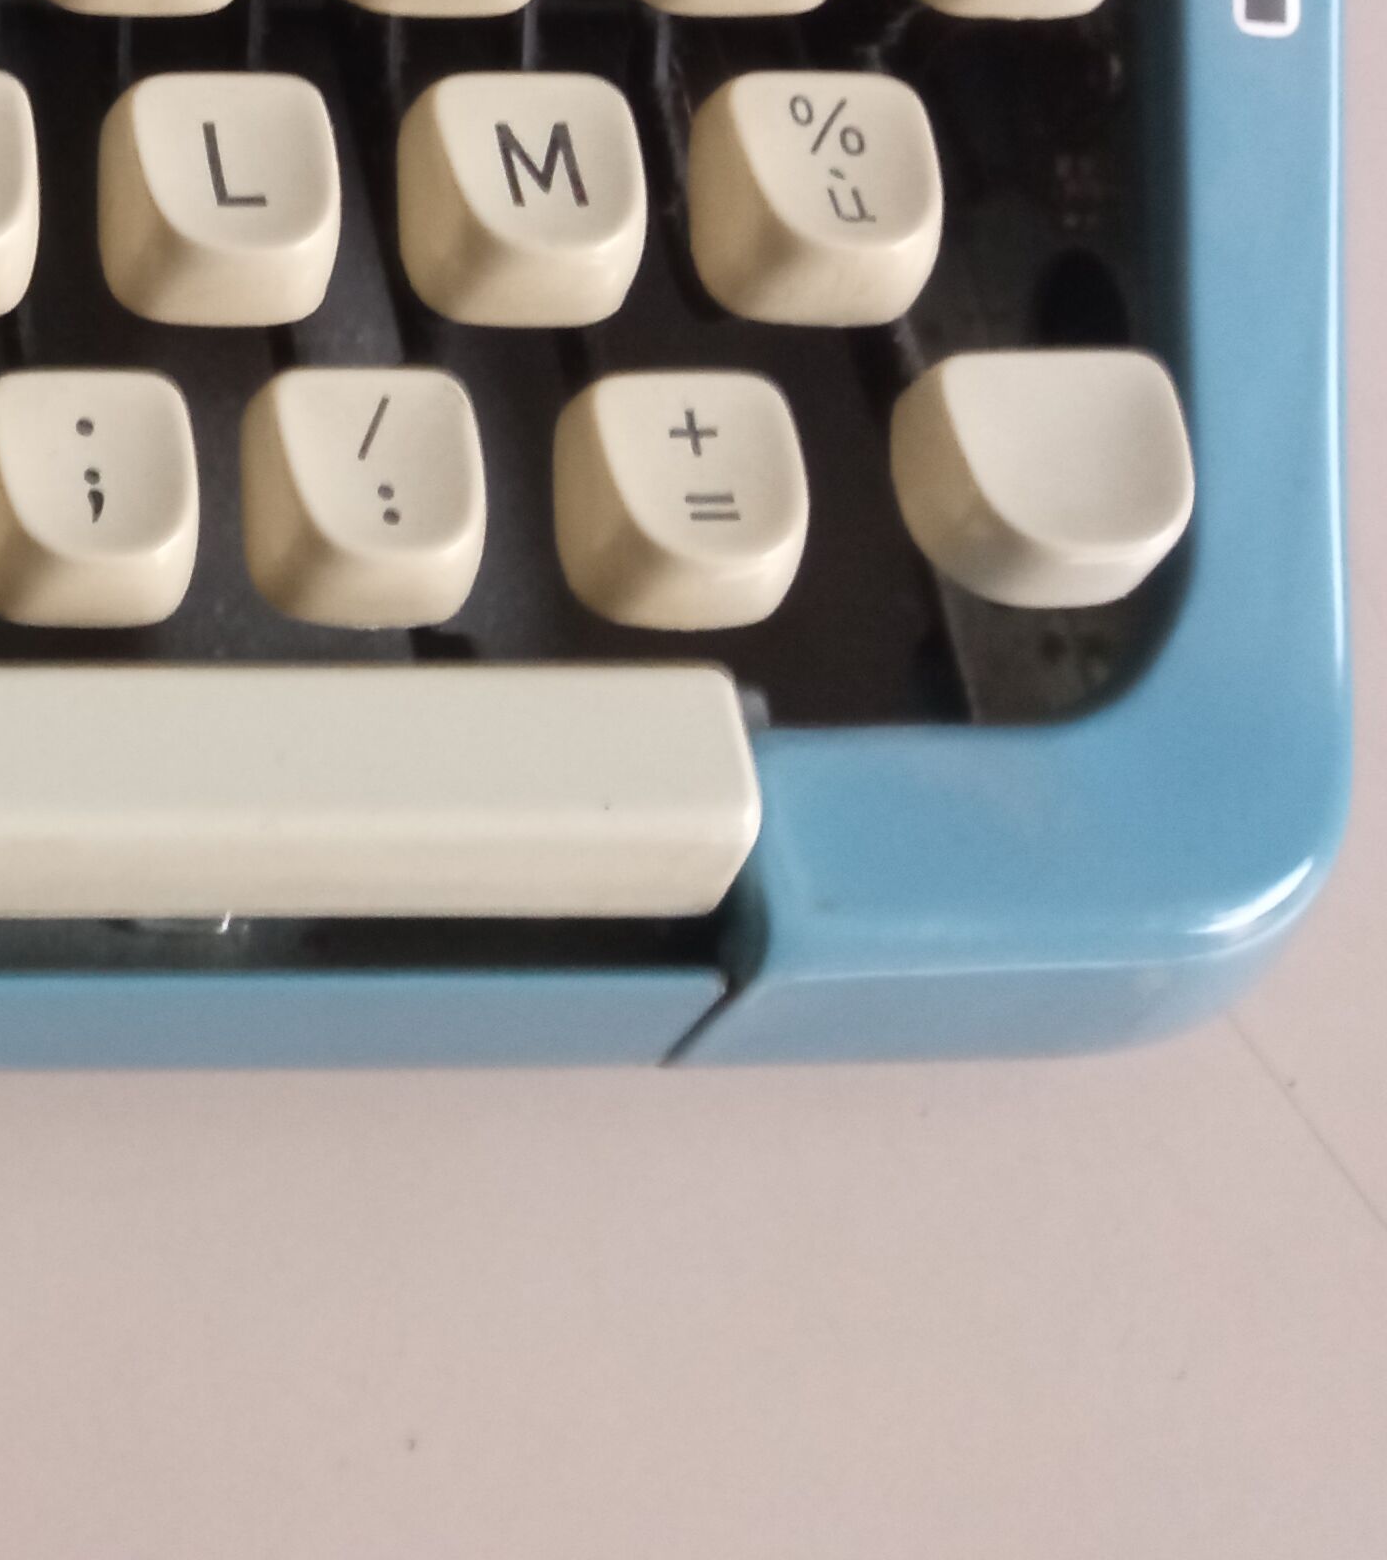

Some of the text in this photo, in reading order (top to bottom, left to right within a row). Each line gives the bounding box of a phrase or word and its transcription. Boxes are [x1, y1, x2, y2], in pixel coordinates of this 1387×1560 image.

[788, 94, 867, 157] %
[201, 121, 268, 208] L
[494, 121, 589, 208] M
[357, 395, 390, 461] /
[668, 408, 718, 457] +
[683, 491, 742, 522] =
